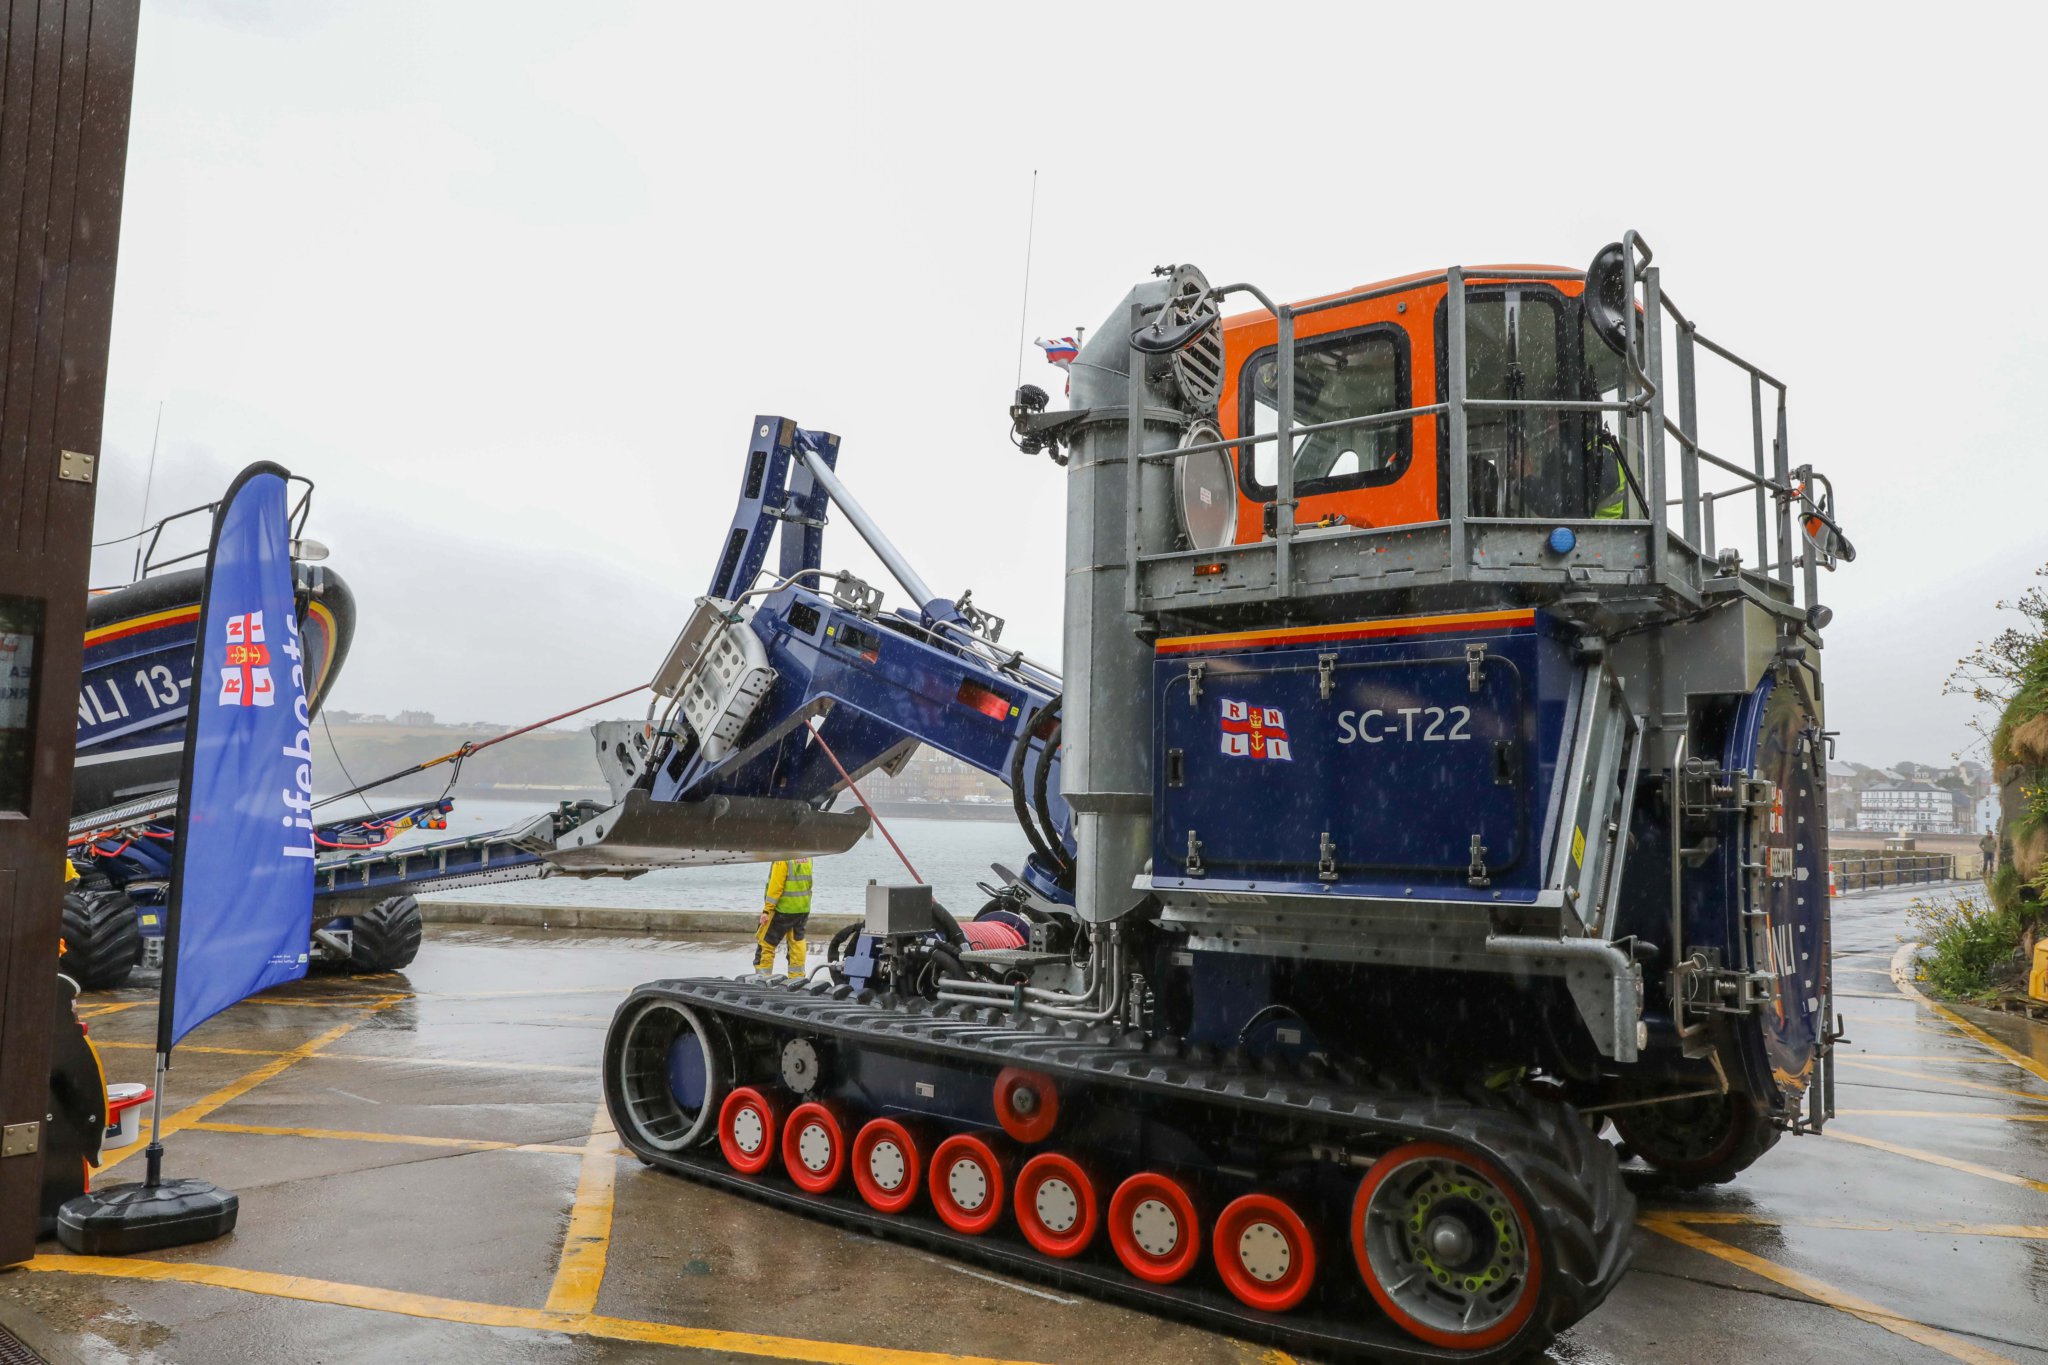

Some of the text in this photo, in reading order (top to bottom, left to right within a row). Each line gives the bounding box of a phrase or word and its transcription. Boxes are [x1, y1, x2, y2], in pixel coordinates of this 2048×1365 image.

[224, 622, 243, 693] R N
[135, 656, 195, 709] 13-
[255, 678, 271, 693] L
[1229, 703, 1280, 724] R N
[1337, 705, 1471, 744] SC-T22
[1231, 737, 1242, 753] L
